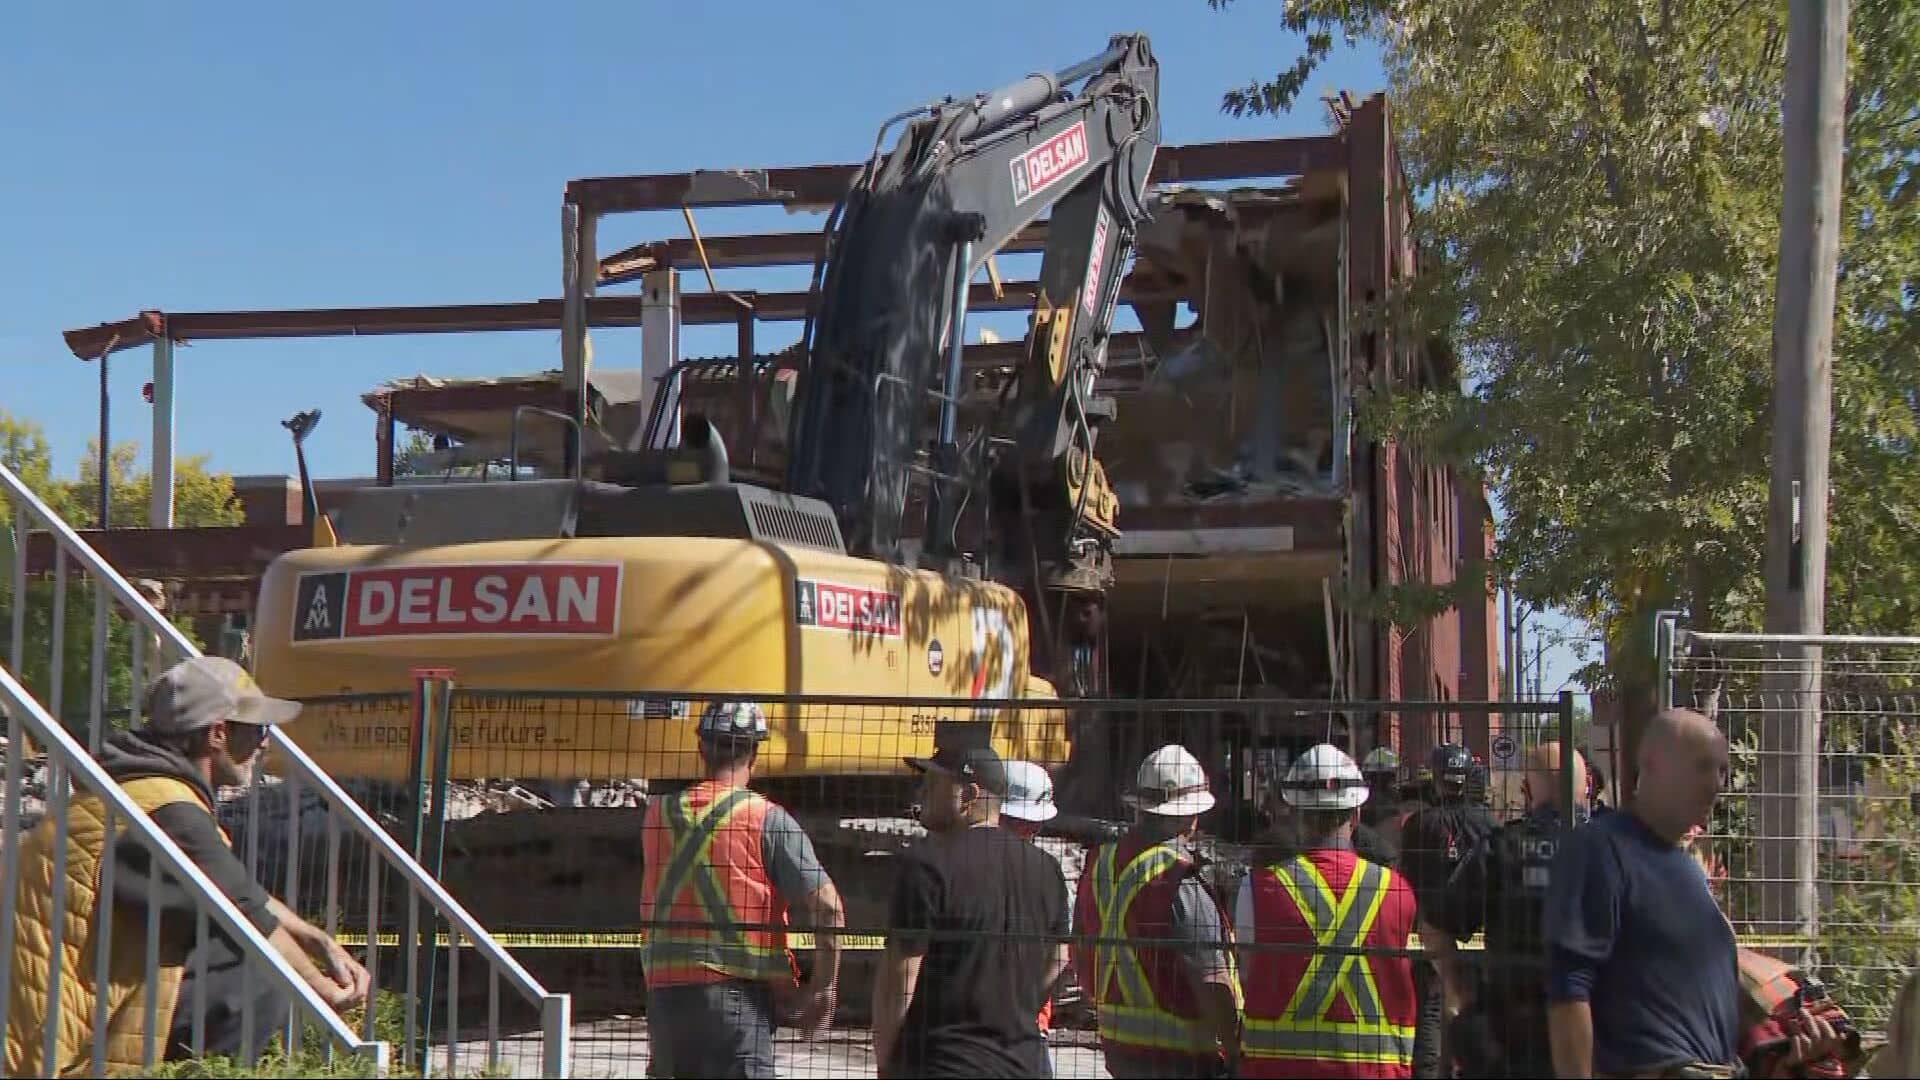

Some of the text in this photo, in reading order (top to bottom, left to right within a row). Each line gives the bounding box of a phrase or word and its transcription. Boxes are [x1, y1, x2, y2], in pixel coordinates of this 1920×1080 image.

[1028, 131, 1084, 186] DELSAN
[358, 575, 601, 626] DELSAN
[820, 590, 897, 628] DELSAN
[478, 718, 547, 745] future
